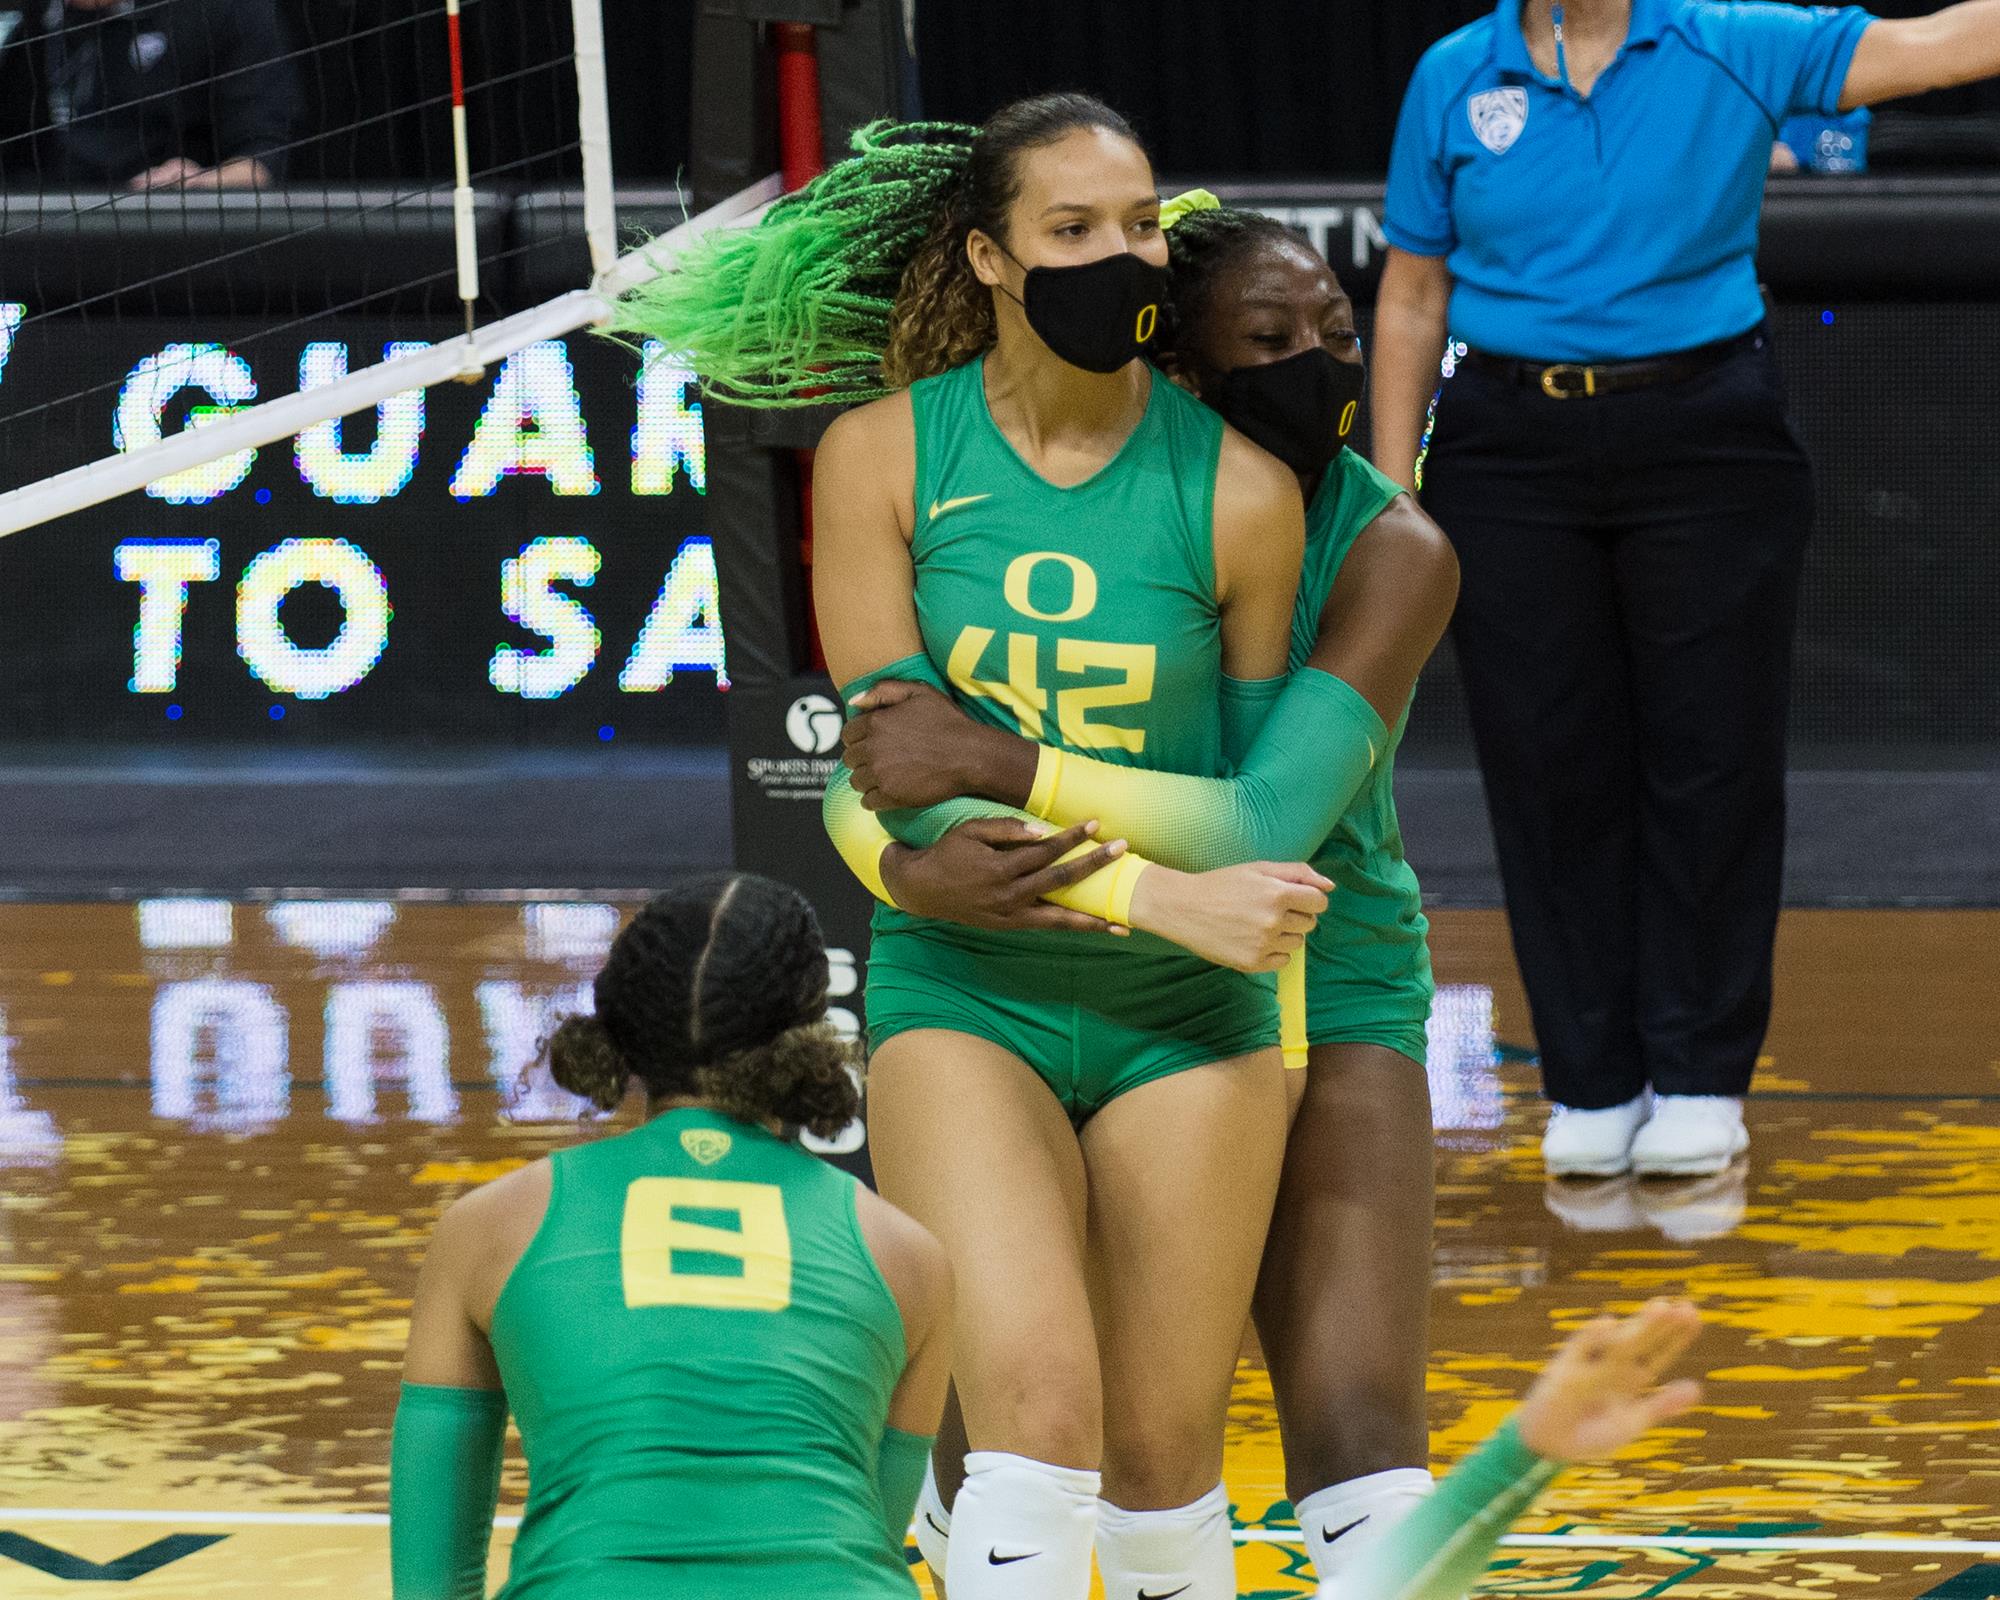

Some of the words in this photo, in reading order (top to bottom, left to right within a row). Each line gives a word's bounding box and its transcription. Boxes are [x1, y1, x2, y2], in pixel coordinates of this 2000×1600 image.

[114, 538, 394, 699] TO
[1004, 552, 1097, 622] O
[947, 625, 1157, 754] 42
[621, 1177, 792, 1313] 8
